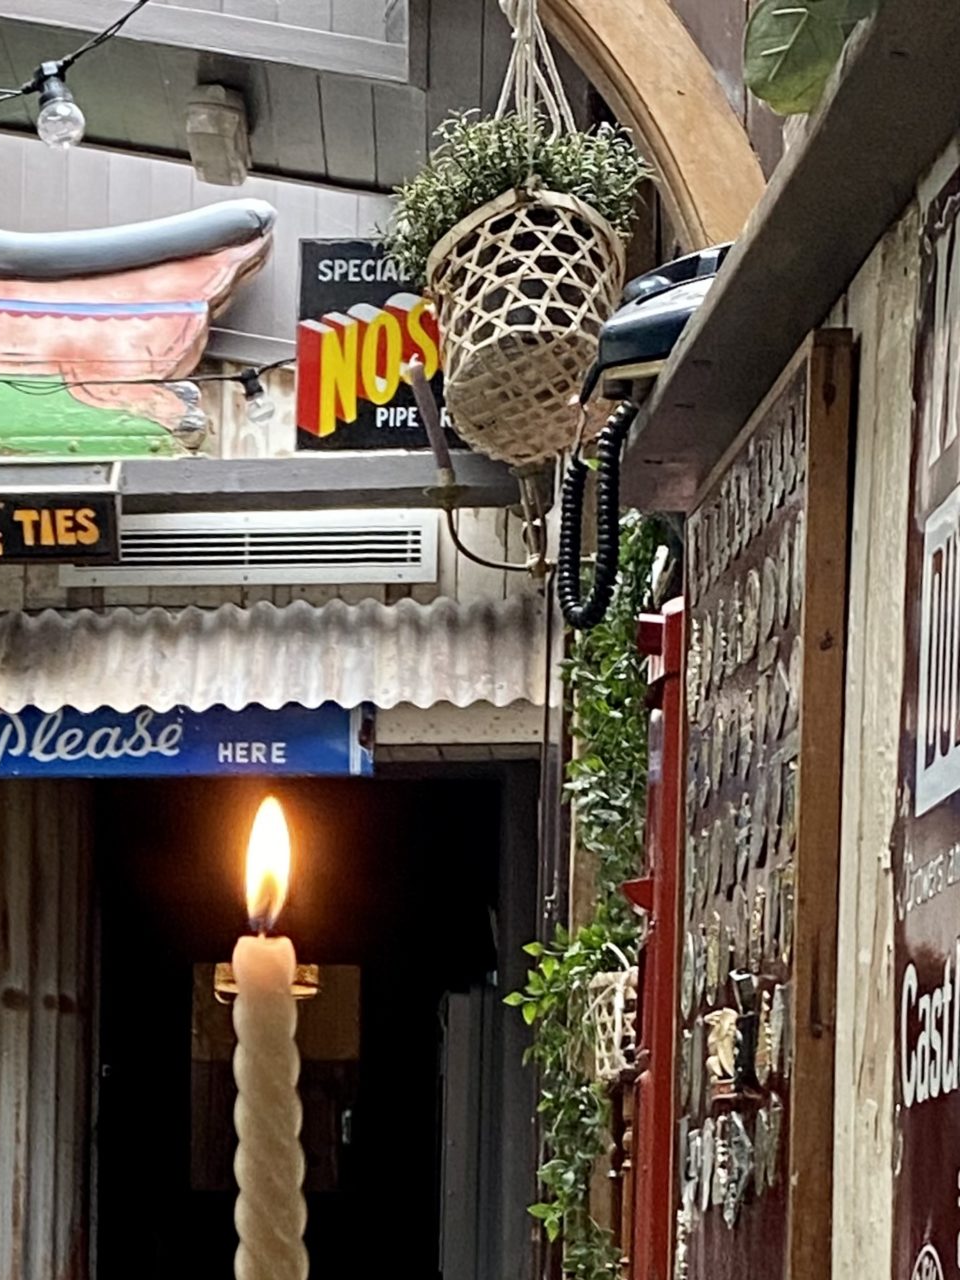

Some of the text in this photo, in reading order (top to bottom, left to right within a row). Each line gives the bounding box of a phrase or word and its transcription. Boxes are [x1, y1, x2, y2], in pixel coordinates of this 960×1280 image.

[318, 259, 410, 282] SPECIAL
[376, 407, 419, 427] PIPE
[13, 509, 99, 546] TIES
[218, 742, 287, 763] HERE
